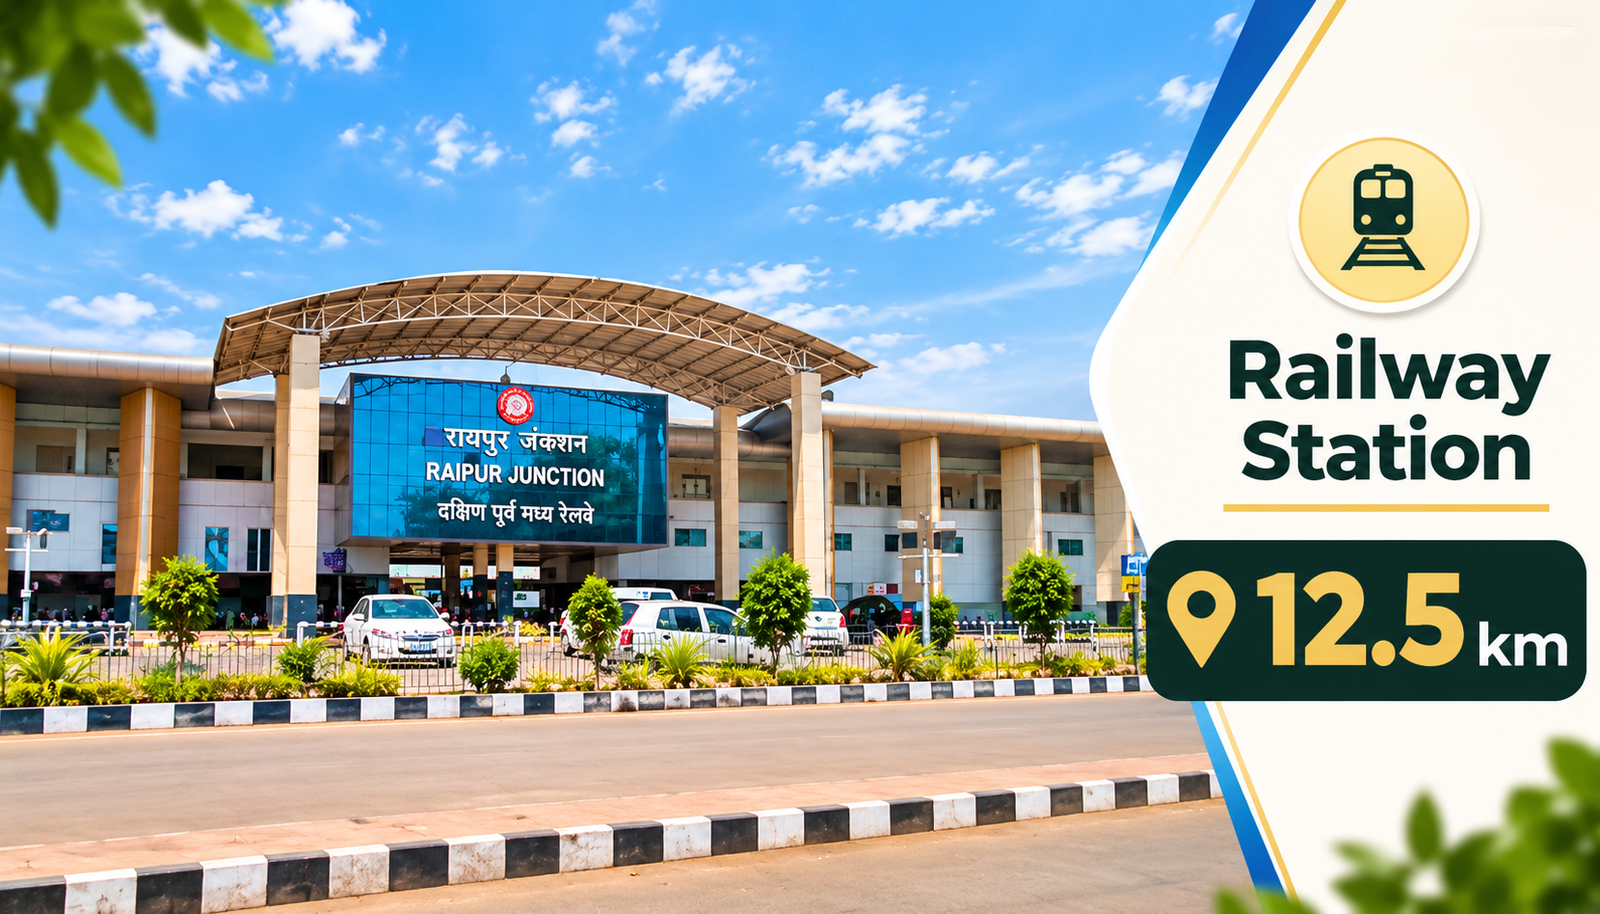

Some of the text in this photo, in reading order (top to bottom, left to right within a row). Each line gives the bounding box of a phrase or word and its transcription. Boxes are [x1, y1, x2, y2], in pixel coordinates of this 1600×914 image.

[443, 426, 588, 457] रायपुर जंकशन
[425, 462, 605, 487] RAIPUR JUNCTION
[437, 497, 487, 522] दक्षिण
[558, 500, 595, 525] रेलवे
